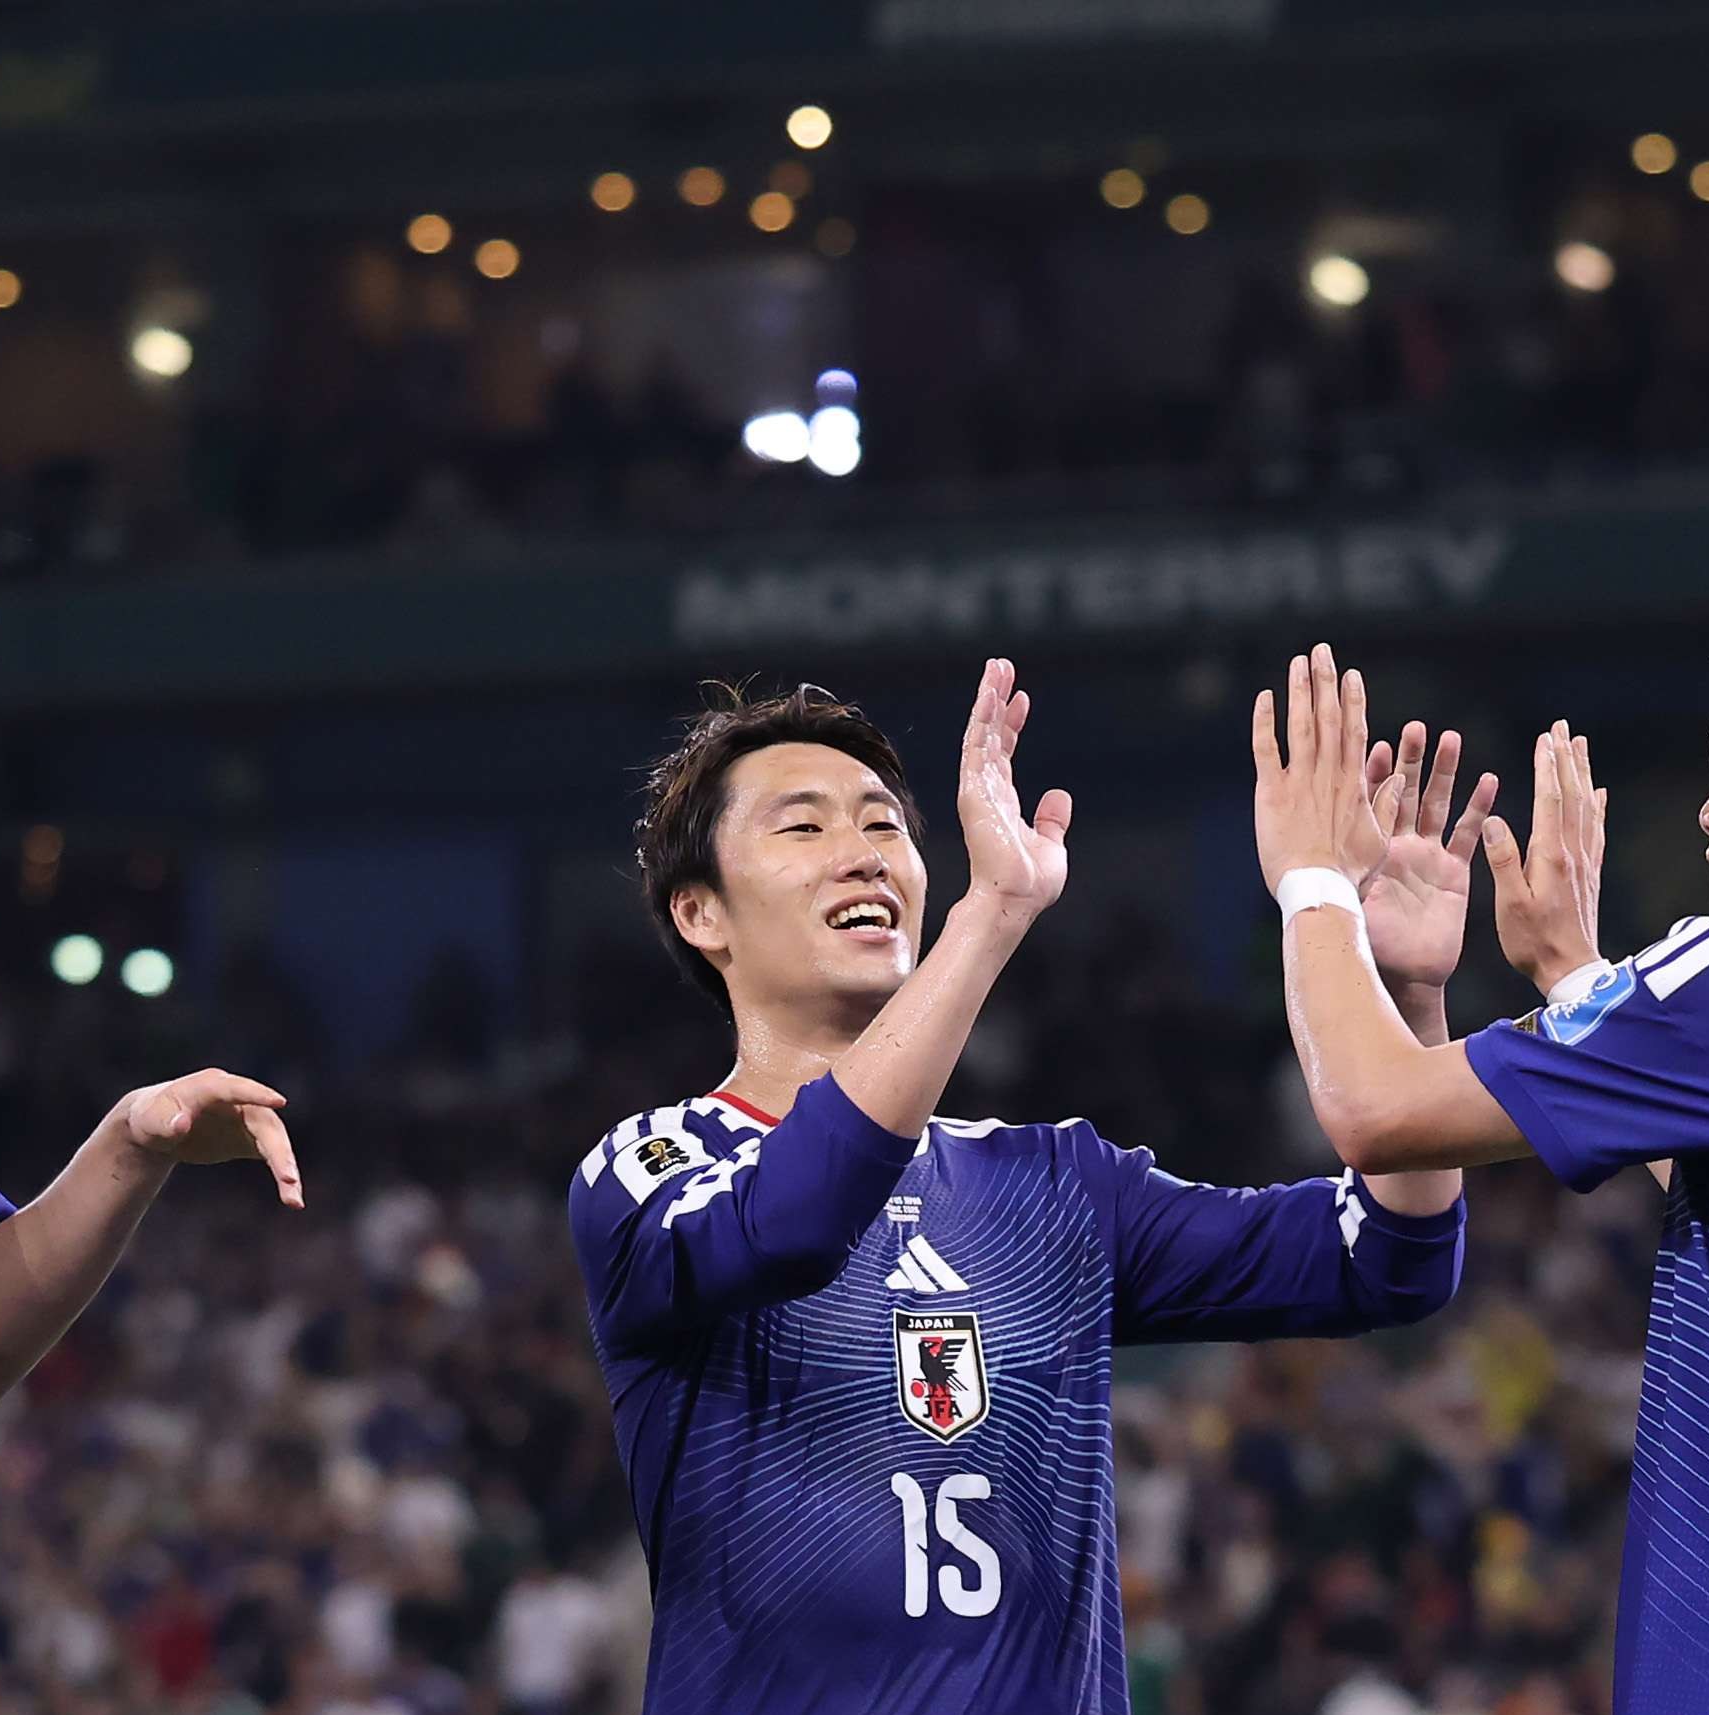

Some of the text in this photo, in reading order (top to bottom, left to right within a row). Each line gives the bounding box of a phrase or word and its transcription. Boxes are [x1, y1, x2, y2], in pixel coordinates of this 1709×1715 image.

[907, 1319, 954, 1329] JAPAN
[922, 1400, 962, 1419] JFA
[891, 1473, 1002, 1618] 15
